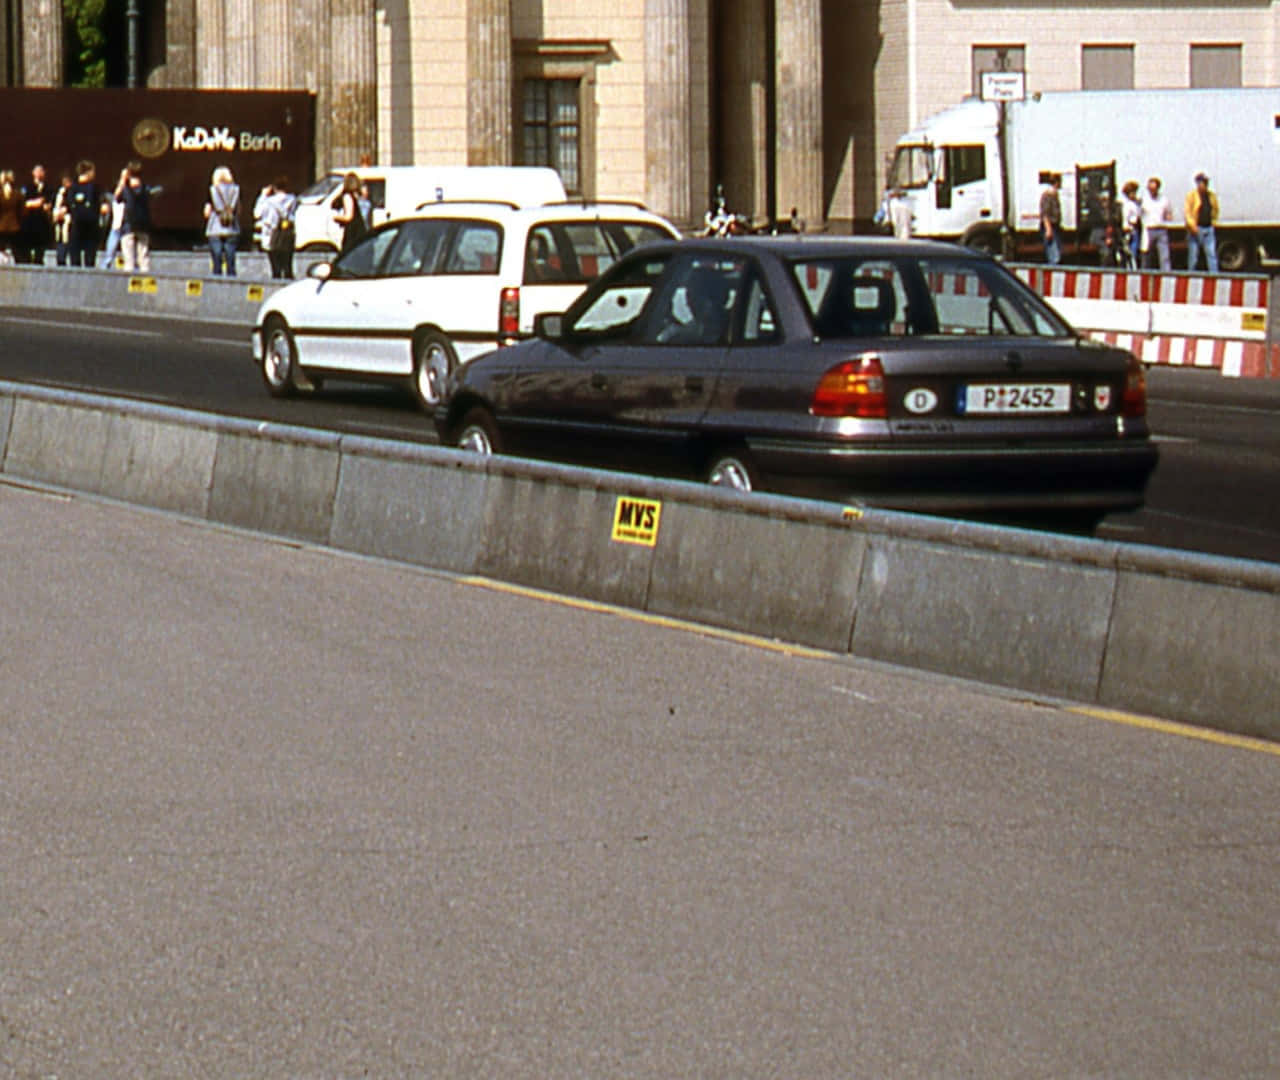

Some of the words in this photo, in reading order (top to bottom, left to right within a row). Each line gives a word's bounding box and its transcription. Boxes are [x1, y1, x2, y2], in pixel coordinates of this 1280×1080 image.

[173, 126, 236, 150] KaDeWe
[239, 131, 282, 151] Berlin
[914, 392, 927, 410] D
[1008, 388, 1055, 408] 2452
[618, 500, 655, 529] MVS
